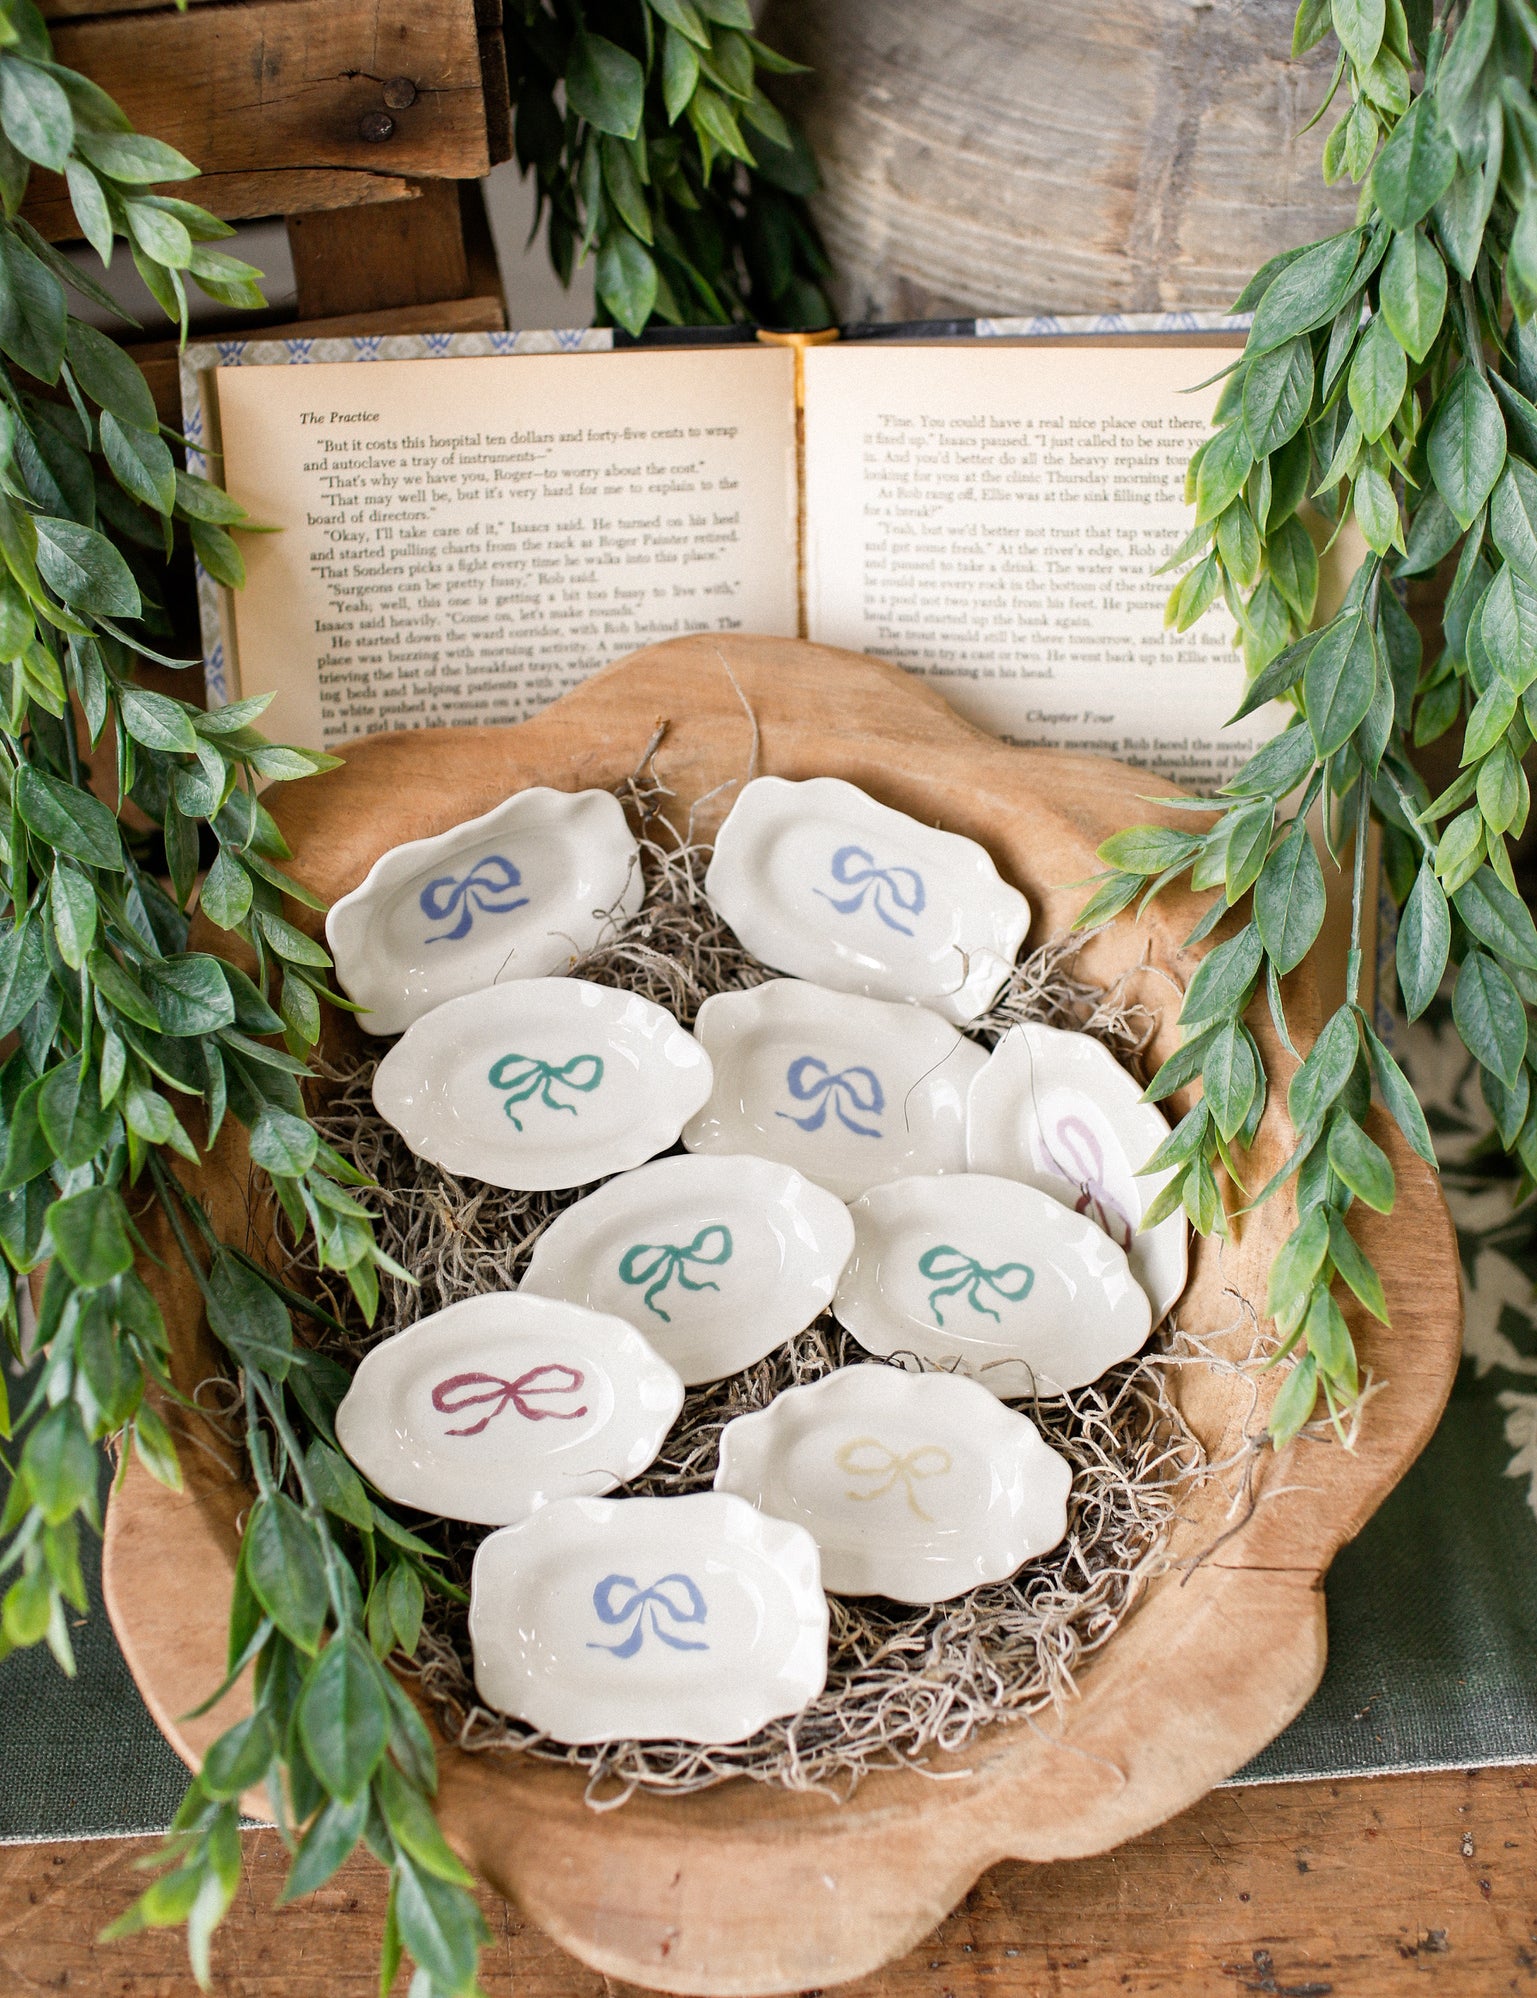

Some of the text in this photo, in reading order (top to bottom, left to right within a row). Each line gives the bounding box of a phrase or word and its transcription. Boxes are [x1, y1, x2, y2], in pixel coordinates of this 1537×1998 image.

[300, 411, 379, 424] The Practice
[920, 415, 945, 428] You
[950, 415, 985, 428] could
[990, 415, 1021, 428] have
[1027, 417, 1033, 428] a
[1039, 416, 1063, 428] real
[1069, 417, 1095, 428] nice
[1102, 416, 1134, 431] place
[1142, 417, 1162, 428] out
[1170, 416, 1206, 430] there,
[318, 427, 737, 452] "But it costs this hospital ten dollars and forty-five cents to wrap
[939, 433, 976, 446] Isaacs
[982, 434, 1028, 449] paused.
[1051, 435, 1074, 449] just
[1078, 432, 1116, 446] called
[1121, 434, 1134, 446] to
[1138, 434, 1154, 446] be
[1157, 436, 1183, 447] sure
[304, 458, 327, 471] and
[333, 456, 395, 469] autoclave
[400, 458, 407, 467] a
[412, 456, 436, 469] tray
[442, 453, 455, 465] of
[320, 475, 366, 488] "That's
[371, 474, 397, 488] why
[403, 475, 422, 484] we
[427, 471, 456, 484] have
[462, 471, 489, 483] you,
[562, 468, 599, 479] worry
[605, 463, 640, 476] about
[647, 463, 666, 474] the
[671, 461, 704, 474] cost."
[913, 469, 931, 482] for
[937, 473, 959, 484] you
[965, 472, 976, 482] at
[981, 470, 1000, 482] the
[1006, 471, 1041, 483] clinic
[1046, 471, 1108, 485] Thursday
[1114, 472, 1168, 486] morning
[1174, 472, 1185, 483] at
[322, 477, 738, 506] "That may well be, but it's very hard for me to explain to the
[897, 487, 922, 499] Rob
[925, 490, 954, 502] rang
[982, 487, 1010, 501] Ellie
[1015, 491, 1039, 501] was
[1044, 490, 1055, 501] at
[1060, 489, 1079, 501] the
[1084, 488, 1108, 501] sink
[1114, 488, 1150, 504] filling
[1156, 489, 1175, 501] the
[307, 507, 435, 525] board of directors."
[324, 512, 739, 543] "Okay, I'll take care of it," Isaacs said. He turned on his heel
[310, 549, 334, 561] and
[339, 547, 384, 560] started
[391, 544, 436, 559] pulling
[442, 542, 480, 555] charts
[486, 540, 517, 552] from
[523, 539, 543, 550] the
[548, 537, 573, 549] rack
[582, 538, 592, 547] as
[600, 536, 636, 550] Roger
[311, 566, 348, 579] "That
[353, 565, 404, 577] Sonders
[409, 563, 441, 576] picks
[447, 564, 453, 572] a
[458, 558, 487, 573] fight
[492, 558, 526, 570] every
[532, 556, 559, 567] time
[565, 554, 579, 565] he
[585, 553, 620, 564] walks
[626, 552, 650, 563] into
[656, 551, 677, 562] this
[328, 584, 393, 596] "Surgeons
[398, 582, 420, 592] can
[426, 579, 441, 590] be
[446, 578, 484, 592] pretty
[539, 573, 564, 584] Rob
[570, 571, 598, 583] said.
[315, 620, 354, 632] Isaacs
[360, 617, 385, 629] said
[391, 614, 441, 628] heavily.
[446, 611, 489, 624] "Come
[495, 612, 514, 622] on,
[520, 609, 544, 620] let's
[550, 607, 583, 618] make
[319, 671, 369, 685] trieving
[374, 670, 393, 681] the
[398, 667, 419, 679] last
[424, 665, 437, 677] of
[442, 664, 460, 676] the
[466, 662, 524, 675] breakfast
[1026, 710, 1114, 724] Chapter Four
